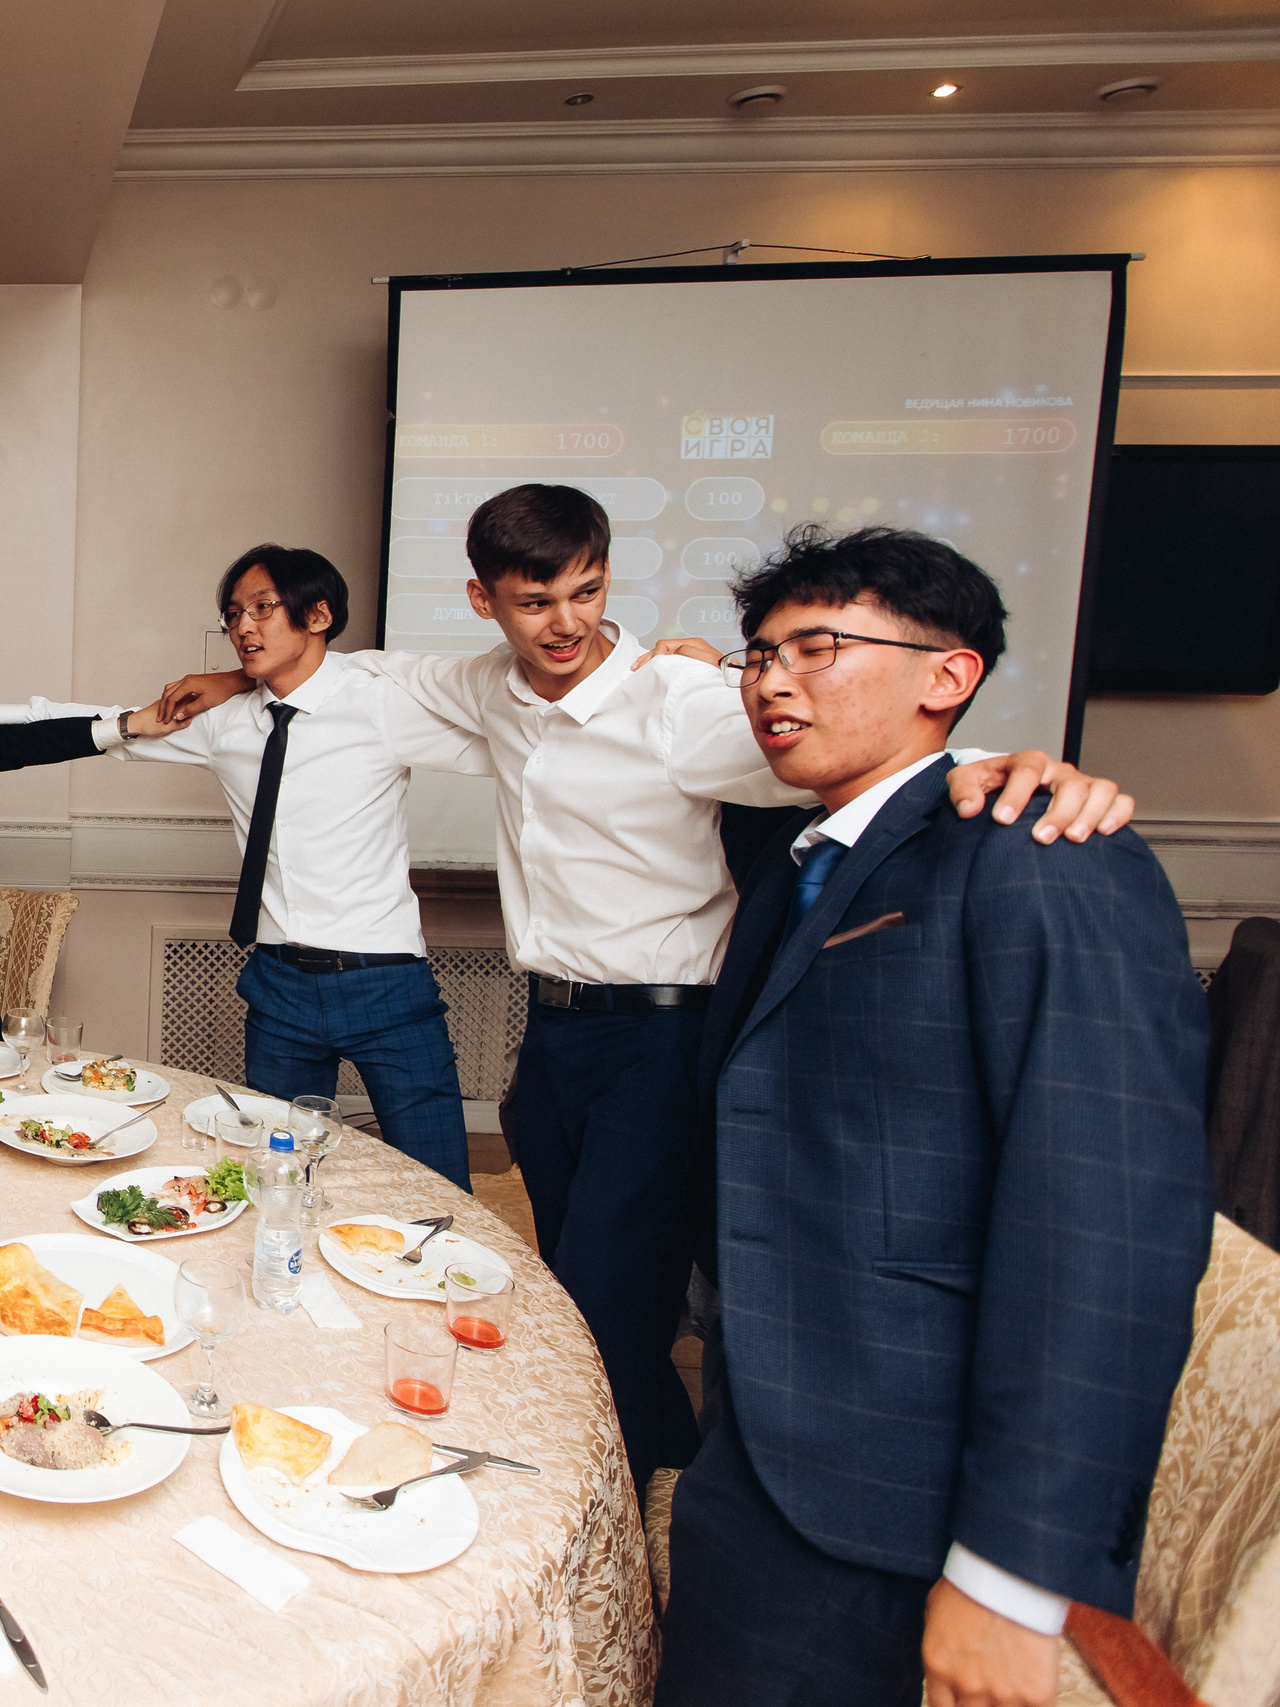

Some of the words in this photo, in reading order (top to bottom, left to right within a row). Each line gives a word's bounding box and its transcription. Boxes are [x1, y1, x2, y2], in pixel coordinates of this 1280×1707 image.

[905, 398, 963, 410] ВЕДУЩАЯ
[967, 398, 1002, 408] НИНА
[1006, 396, 1073, 408] НОВИКОВА
[684, 416, 769, 435] СВОЯ
[399, 435, 469, 447] КОМАНДА
[557, 433, 610, 450] 1700
[832, 431, 908, 444] КОМАНДА
[920, 430, 939, 443] 2:
[1002, 427, 1061, 444] 1700
[684, 439, 768, 457] ИГРА
[707, 491, 742, 505] 100
[702, 552, 737, 565] 100
[432, 608, 474, 621] ДУША
[698, 609, 734, 623] 100
